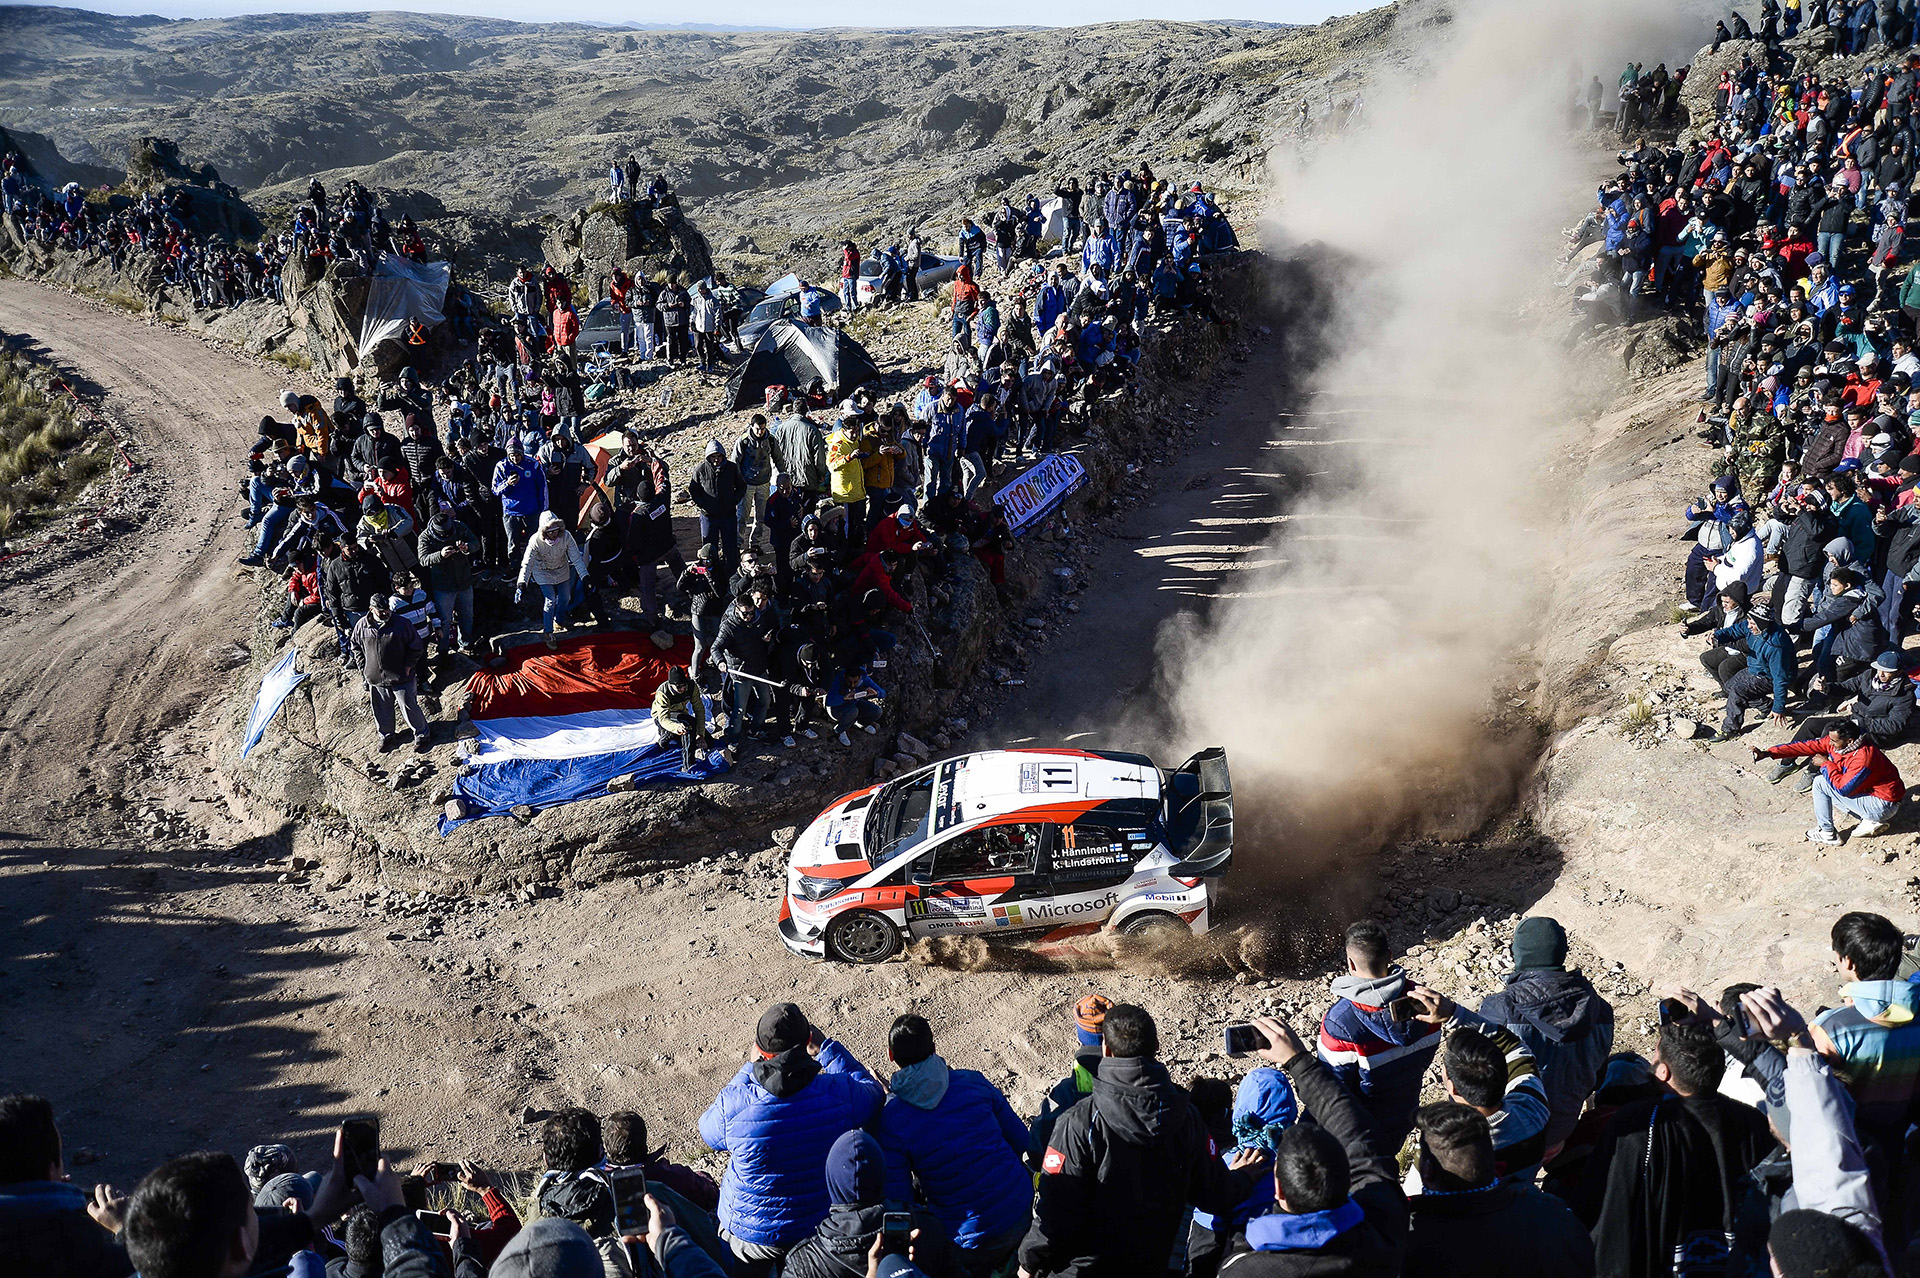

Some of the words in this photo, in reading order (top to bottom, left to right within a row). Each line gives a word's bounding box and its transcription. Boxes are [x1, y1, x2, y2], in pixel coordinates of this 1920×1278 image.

[1043, 768, 1072, 788] 11
[937, 779, 952, 809] Lexar
[849, 815, 860, 838] DENSO
[1061, 824, 1076, 848] 11
[1051, 850, 1060, 858] J.
[1062, 846, 1108, 857] Hänninen
[1053, 860, 1063, 869] K.
[1065, 856, 1114, 868] Lindström
[912, 901, 925, 915] 11
[1027, 891, 1120, 919] Microsoft
[928, 921, 954, 930] DMG
[955, 920, 985, 928] MORI
